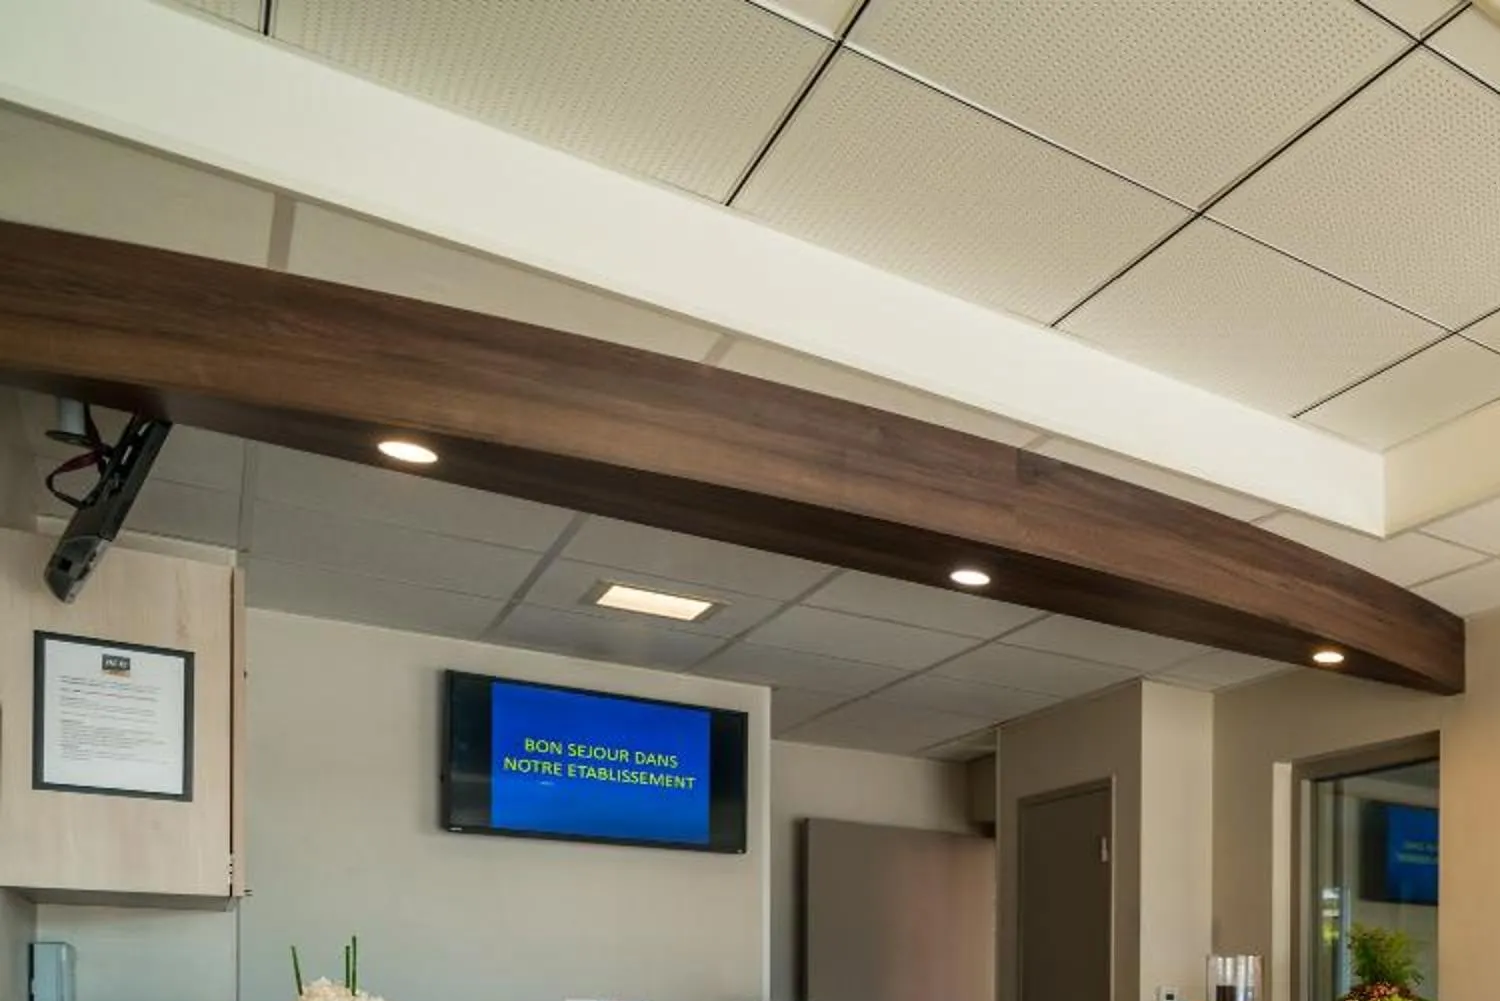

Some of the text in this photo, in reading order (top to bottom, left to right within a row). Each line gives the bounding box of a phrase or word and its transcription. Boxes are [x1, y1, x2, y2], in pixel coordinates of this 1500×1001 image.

[524, 737, 679, 769] BON SEJOUR DANS
[503, 757, 697, 790] NOTRE ETABLISSEMENT
